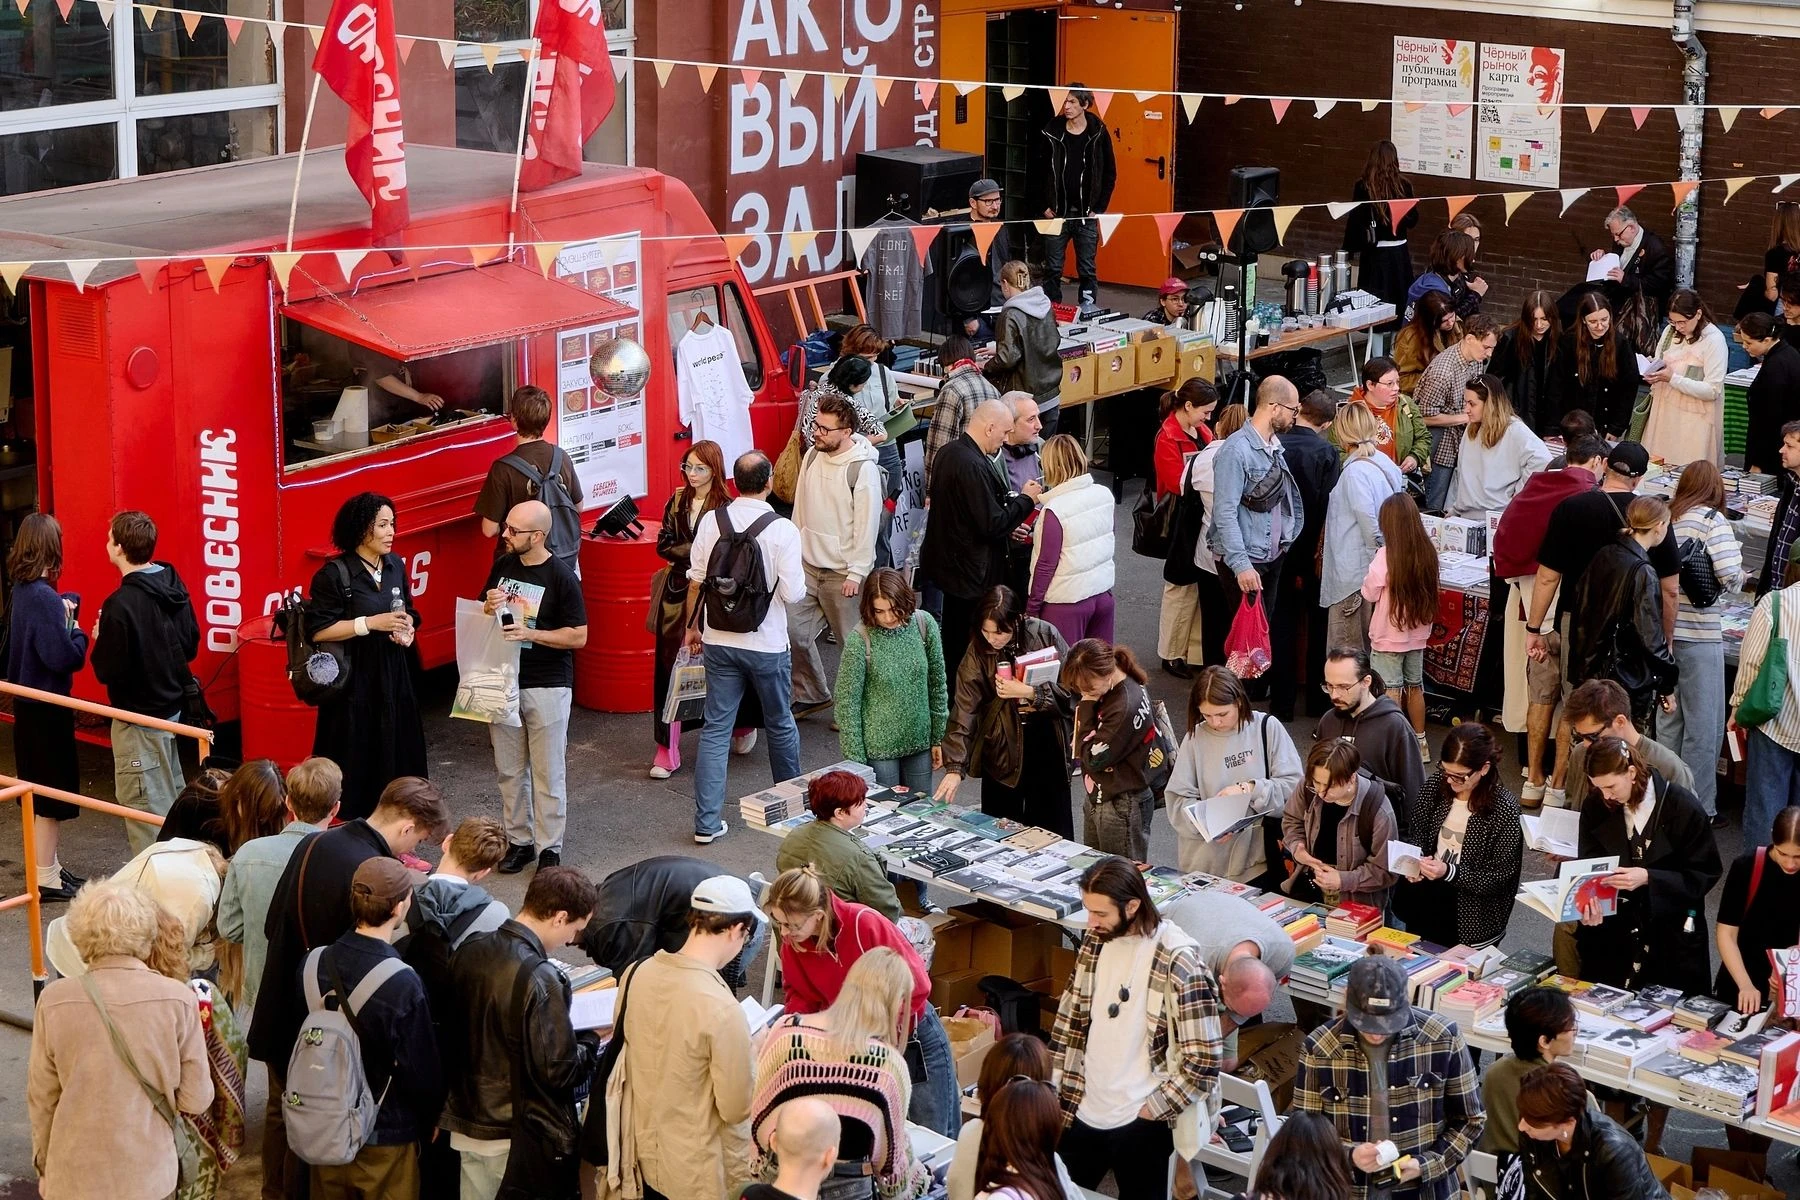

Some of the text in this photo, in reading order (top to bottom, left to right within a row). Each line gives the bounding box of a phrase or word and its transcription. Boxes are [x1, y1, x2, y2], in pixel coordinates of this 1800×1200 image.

[1396, 39, 1438, 54] Чёрный
[1396, 53, 1430, 64] рынок
[1483, 46, 1527, 61] Чёрный
[1402, 63, 1457, 76] публичная
[1482, 60, 1519, 72] рынок
[1401, 76, 1457, 88] программа
[1489, 72, 1520, 85] карта
[731, 46, 877, 175] ВЫЙ
[731, 175, 856, 283] ЗАЛ
[880, 239, 908, 251] LONG
[563, 431, 594, 447] НАПИТКИ
[1224, 749, 1254, 763] BIG CITY
[1225, 757, 1247, 769] VIBES
